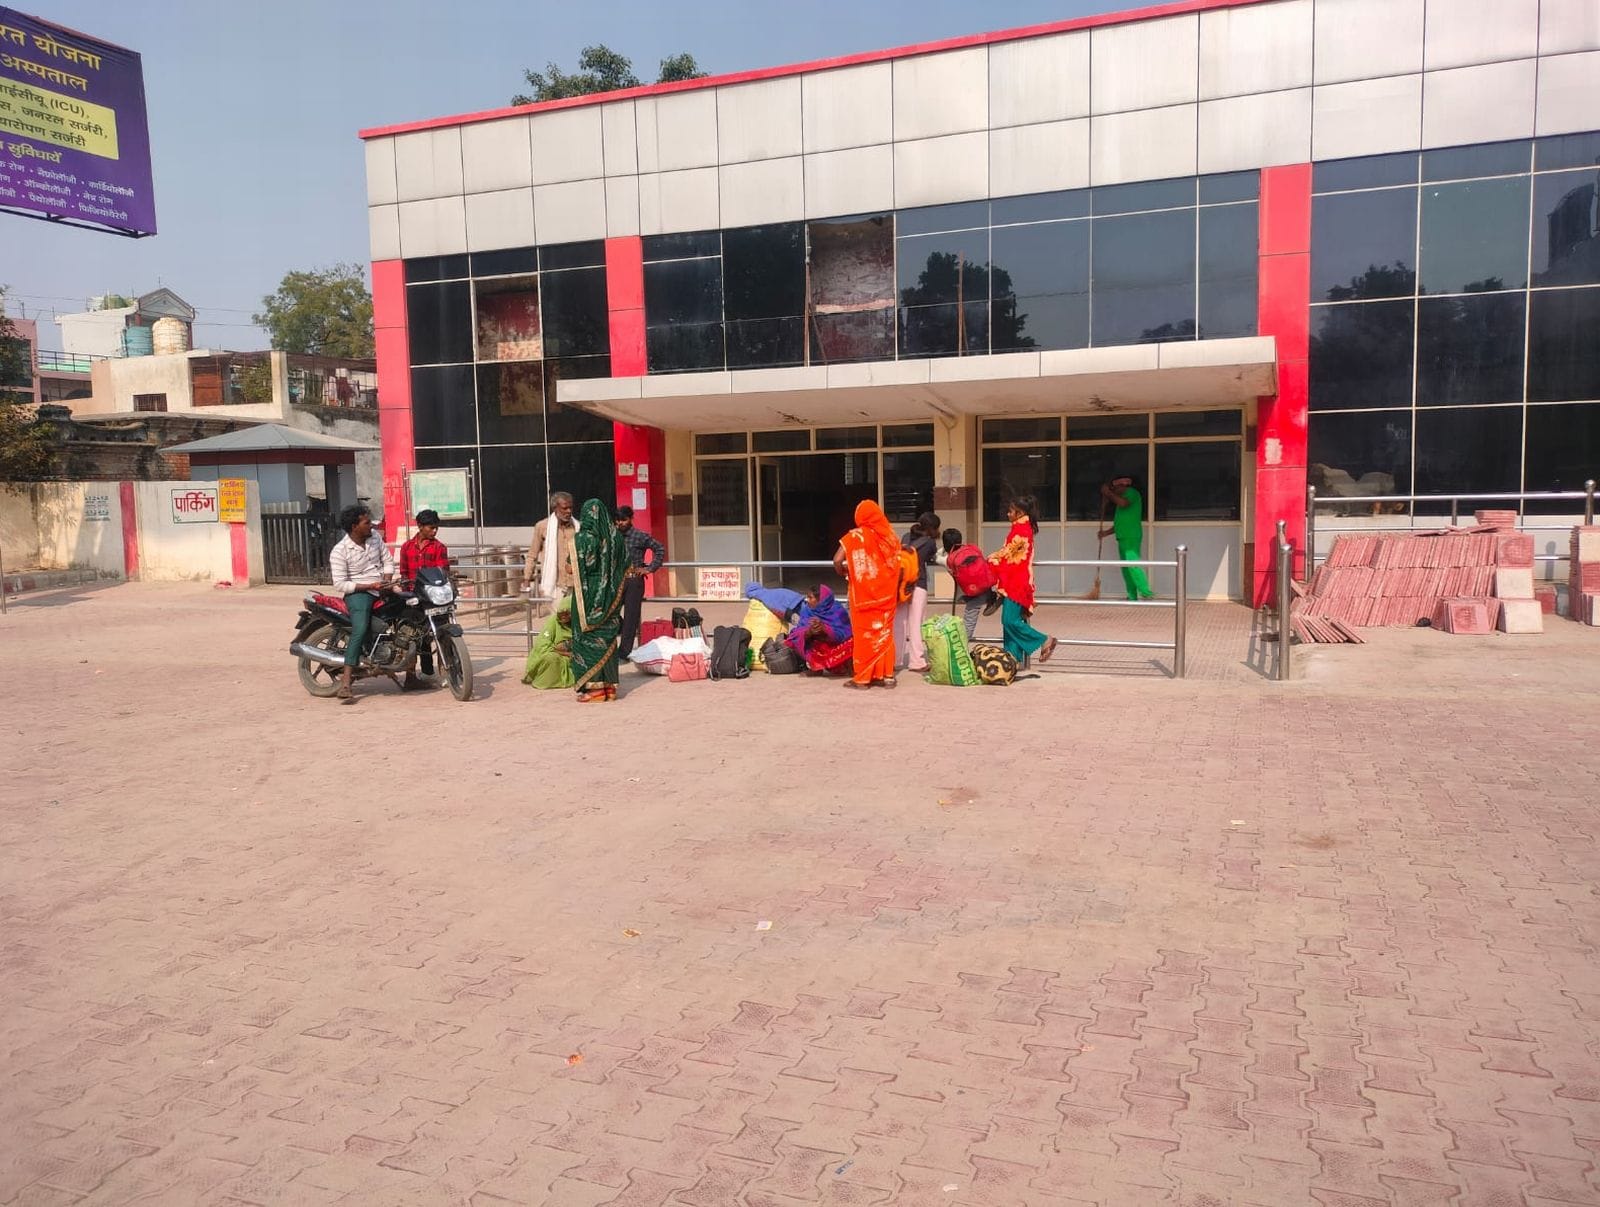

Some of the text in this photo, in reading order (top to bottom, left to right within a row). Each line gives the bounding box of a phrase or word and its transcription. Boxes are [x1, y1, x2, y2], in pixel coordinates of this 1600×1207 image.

[32, 33, 102, 71] योजना
[0, 53, 88, 92] अस्पताल
[21, 106, 64, 126] जनरल
[49, 129, 86, 147] सर्जरी
[174, 492, 215, 512] पार्किंग
